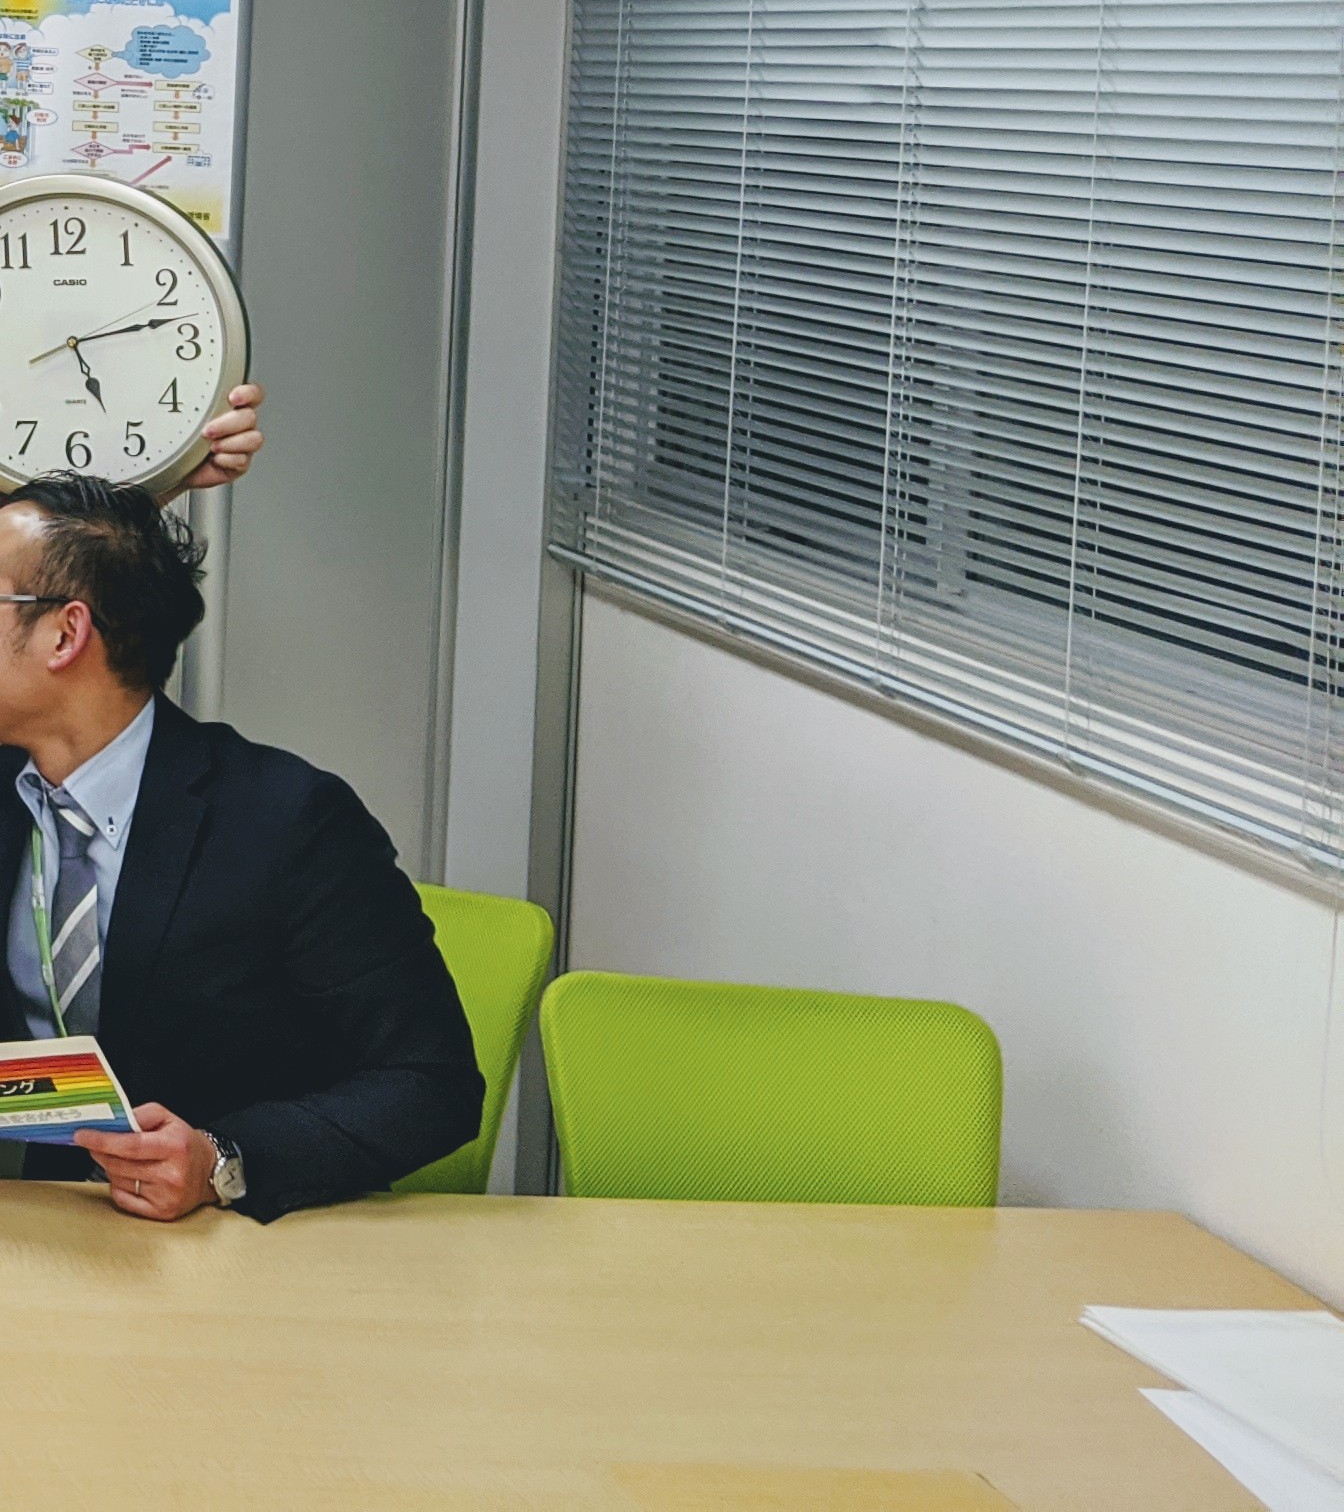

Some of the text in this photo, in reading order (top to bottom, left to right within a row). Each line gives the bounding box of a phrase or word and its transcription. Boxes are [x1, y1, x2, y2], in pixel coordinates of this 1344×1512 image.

[0, 231, 32, 270] 11
[48, 217, 87, 256] 12
[118, 229, 135, 267] 1
[52, 278, 88, 287] CASIO
[154, 267, 179, 307] 2
[175, 322, 202, 361] 3
[158, 376, 184, 413] 4
[14, 419, 39, 456] 7
[64, 430, 92, 469] 6
[122, 420, 147, 457] 5
